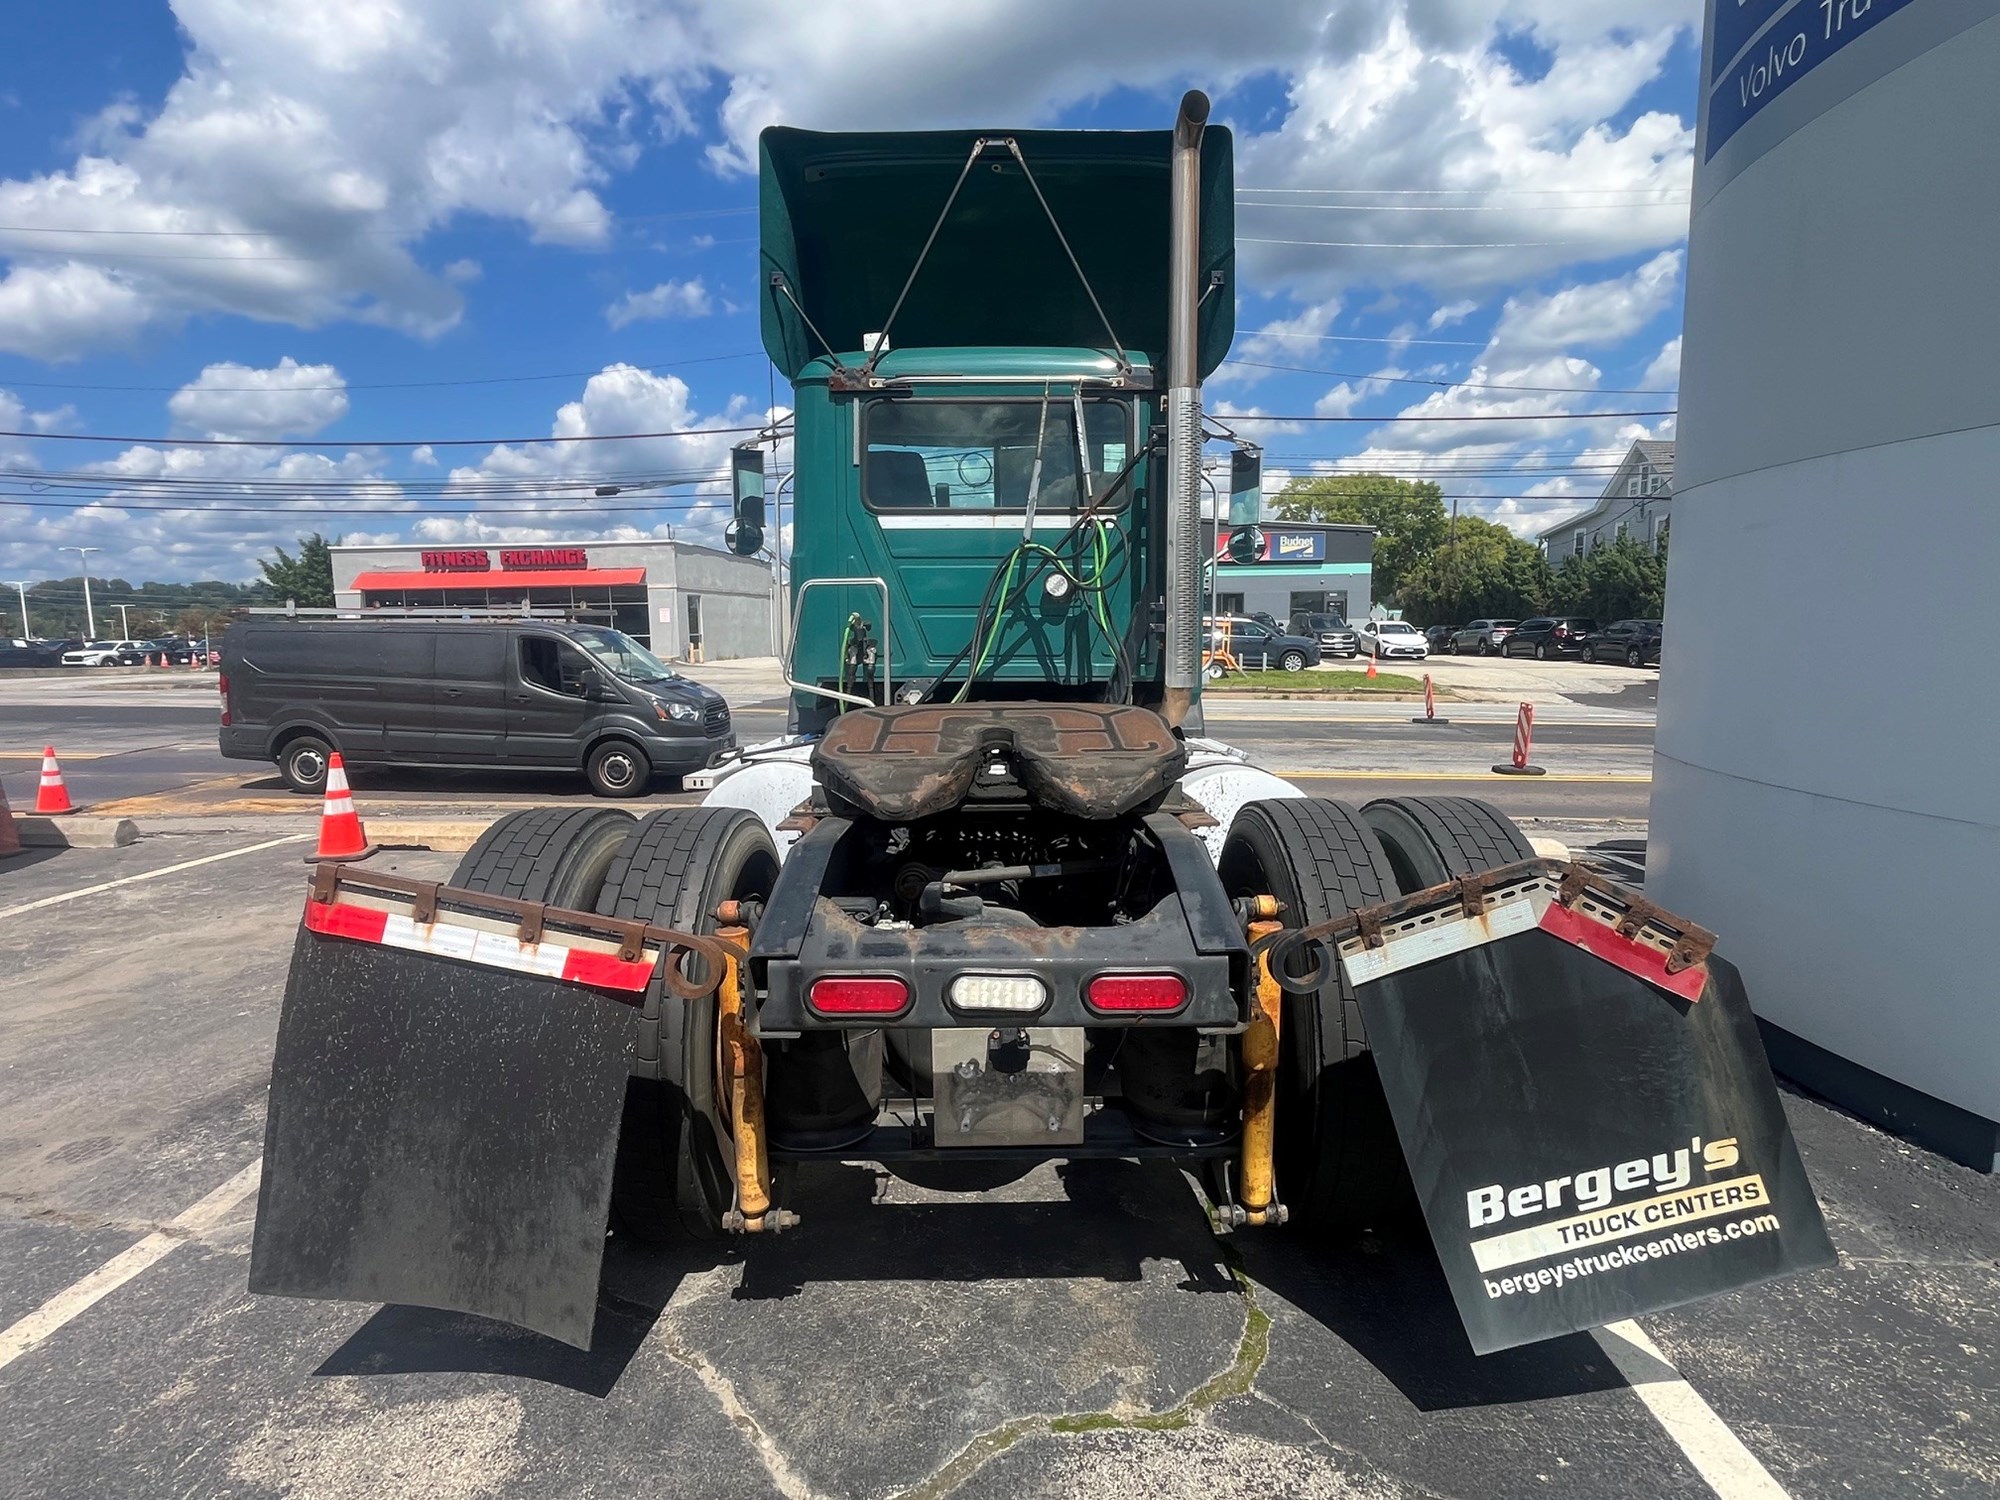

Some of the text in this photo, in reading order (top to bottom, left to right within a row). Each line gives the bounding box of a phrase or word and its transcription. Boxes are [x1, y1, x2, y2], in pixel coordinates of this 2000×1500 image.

[1740, 33, 1806, 107] Volvo
[421, 548, 586, 567] FITNESS EXCHANGE
[1279, 535, 1314, 547] Budget
[1466, 1136, 1739, 1228] Bergey's
[1557, 1181, 1761, 1244] TRUCK CENTERS
[1483, 1213, 1780, 1300] bergeystruckcenters.com
